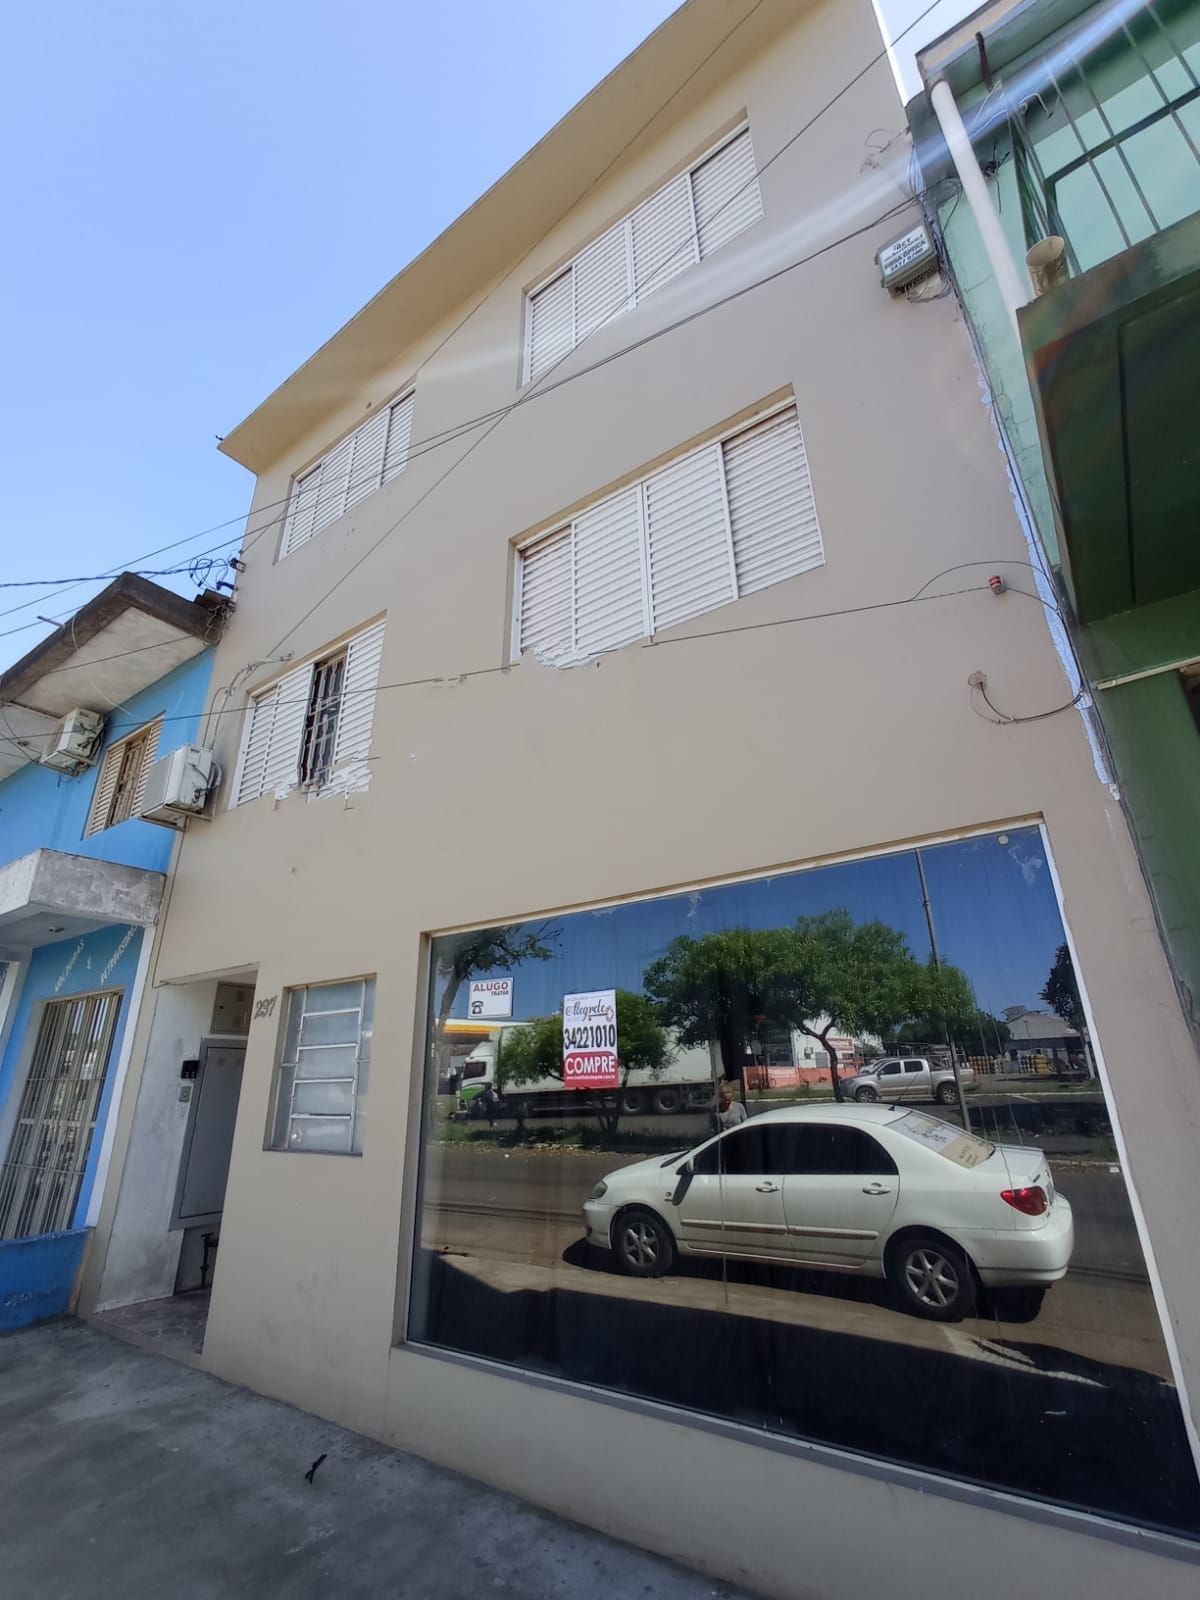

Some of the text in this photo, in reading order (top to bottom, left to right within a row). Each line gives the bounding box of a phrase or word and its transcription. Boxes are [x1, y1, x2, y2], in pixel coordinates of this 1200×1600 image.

[473, 982, 508, 992] ALUGO
[565, 1024, 616, 1050] 34221010
[565, 1056, 615, 1074] COMPRE
